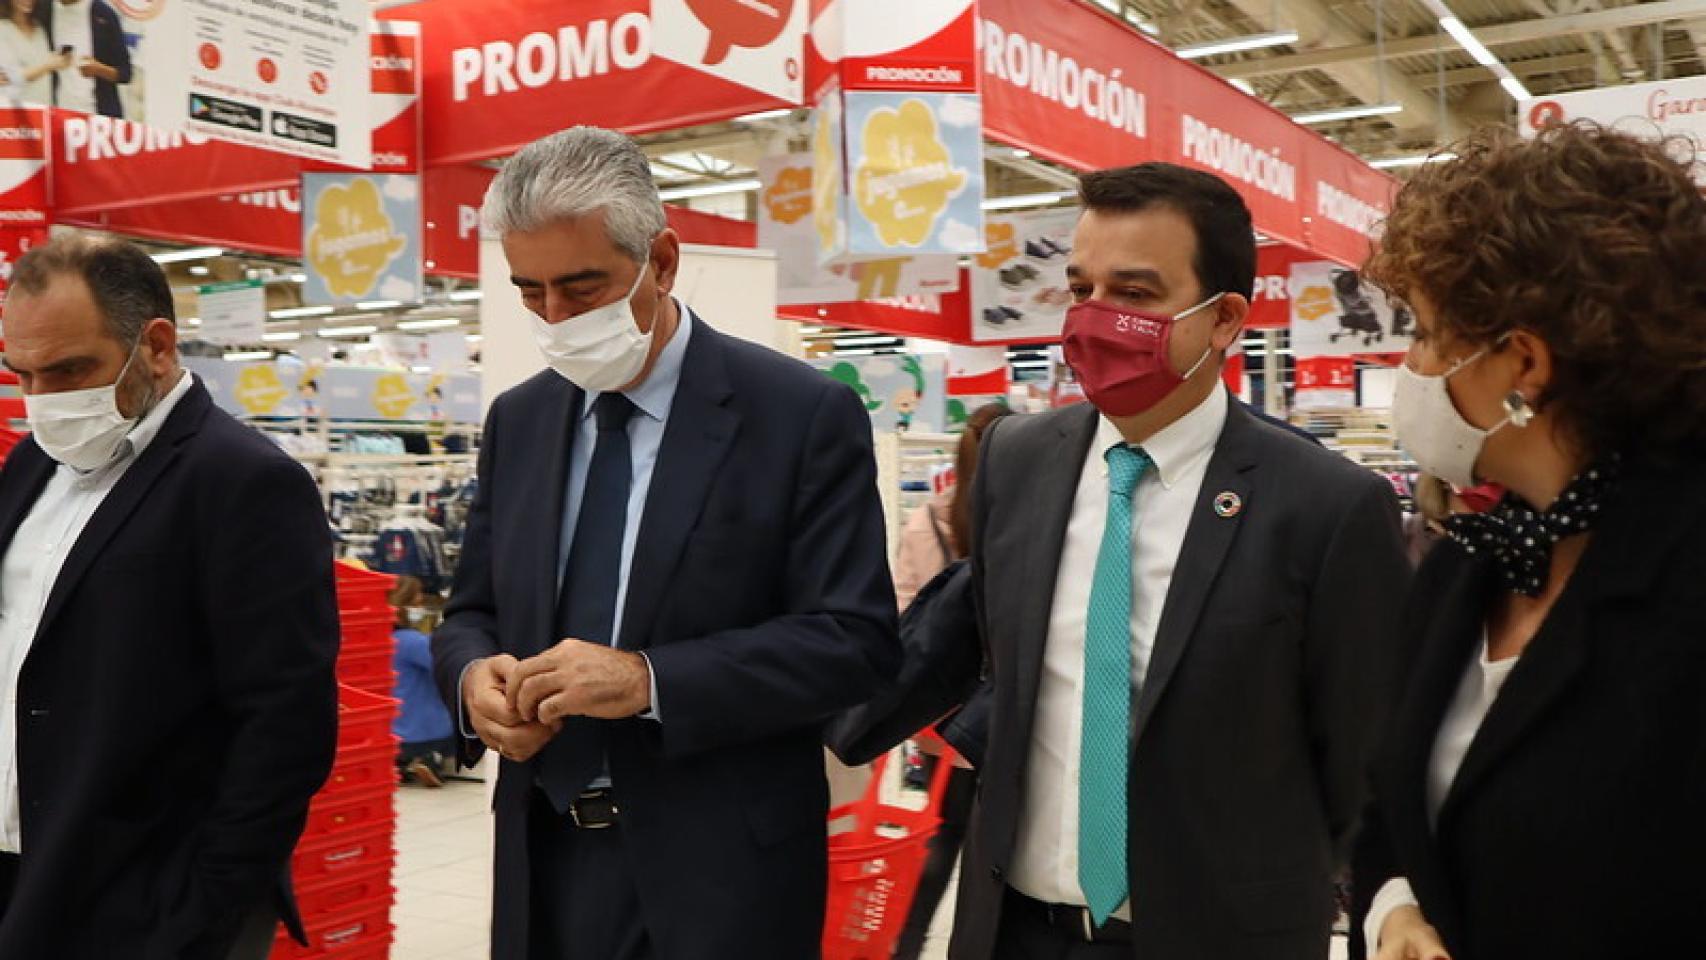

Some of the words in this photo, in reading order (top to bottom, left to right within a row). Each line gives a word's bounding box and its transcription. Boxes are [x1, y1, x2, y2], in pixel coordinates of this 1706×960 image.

[452, 12, 651, 102] PROMO
[866, 65, 963, 82] PROMOCIÓN
[1182, 113, 1295, 202] PROMOCIÓN
